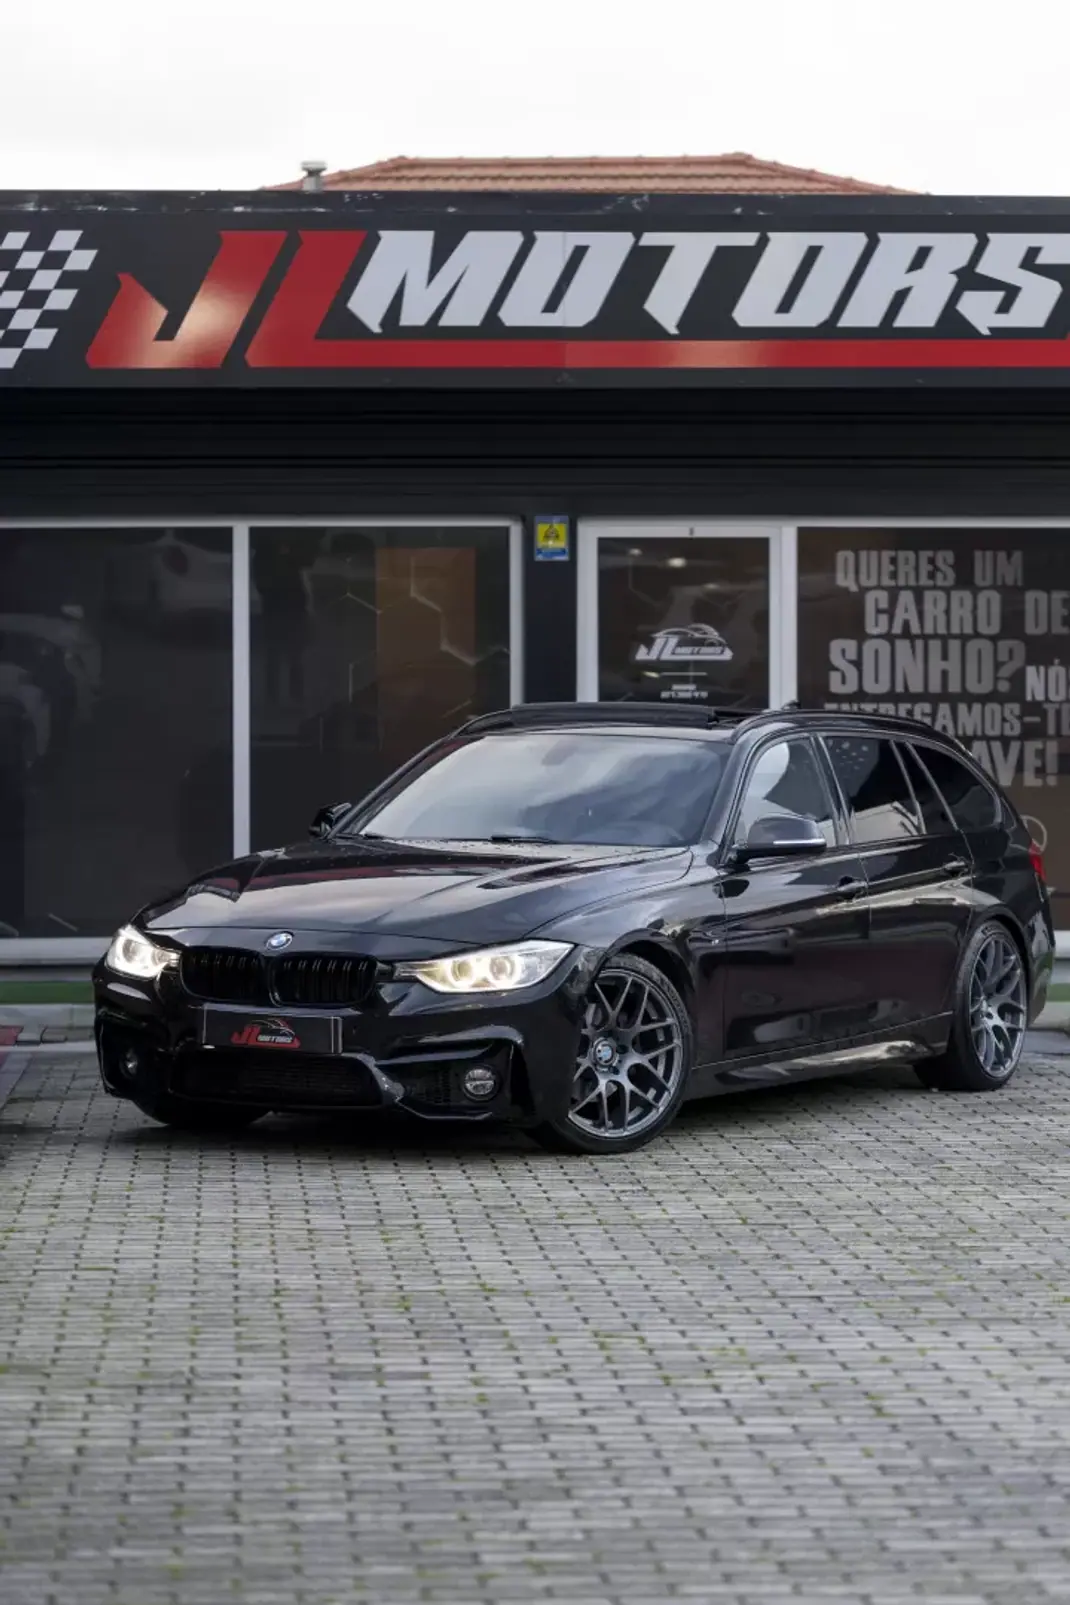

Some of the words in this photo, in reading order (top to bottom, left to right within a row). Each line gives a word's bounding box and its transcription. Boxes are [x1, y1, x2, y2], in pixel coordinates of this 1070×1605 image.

[86, 230, 366, 369] JL
[346, 230, 1070, 335] MOTORS
[836, 550, 956, 592] QUERES
[974, 550, 1023, 587] UM
[864, 590, 1001, 635] CARRO
[1024, 590, 1070, 635] DE
[829, 639, 1026, 694] SONHO?
[1025, 658, 1070, 702] NÓ
